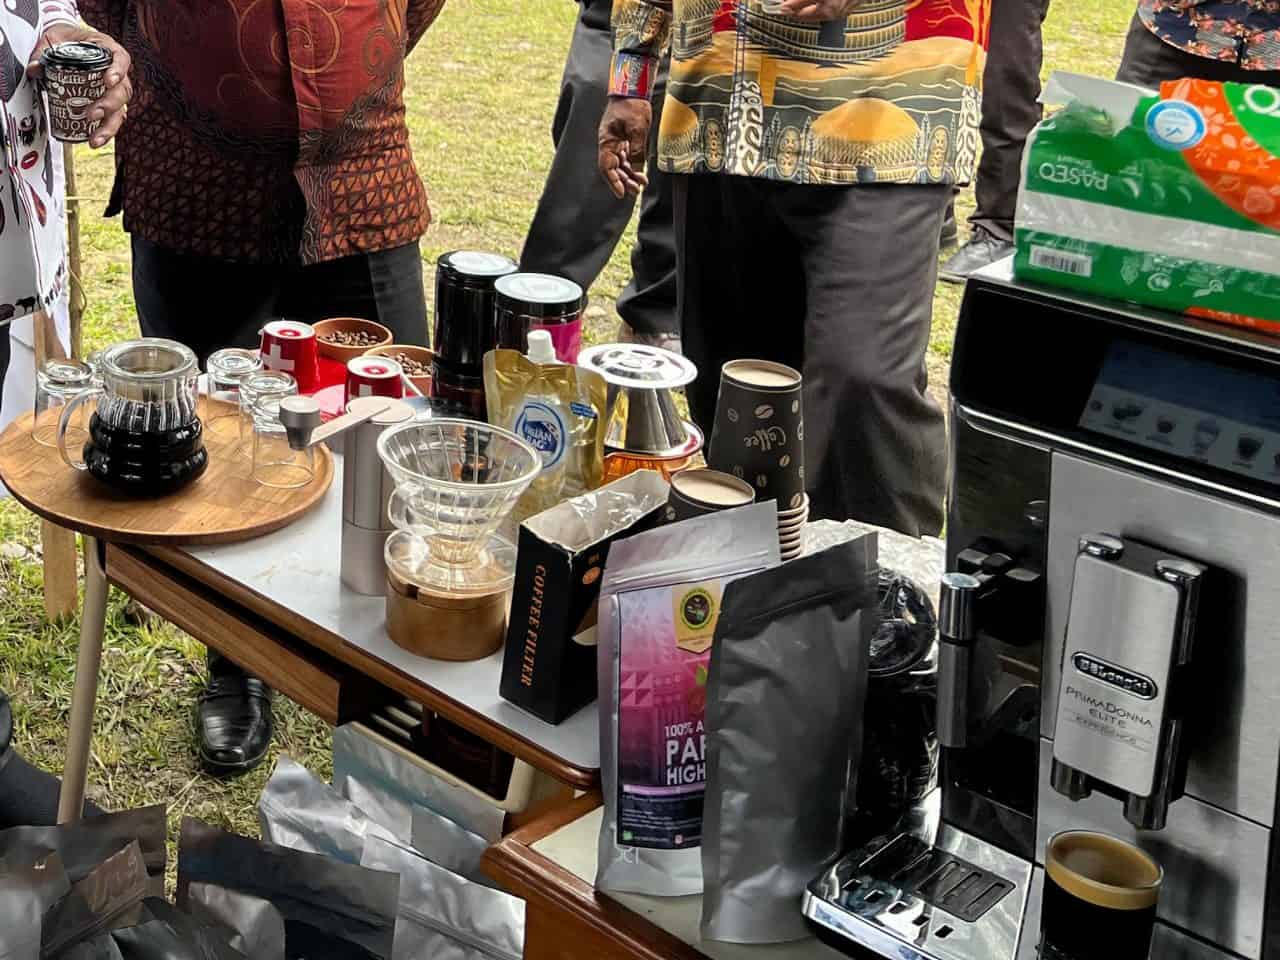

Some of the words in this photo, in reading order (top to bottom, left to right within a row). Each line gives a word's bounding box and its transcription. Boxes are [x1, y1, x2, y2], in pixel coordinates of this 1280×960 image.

[1038, 161, 1110, 191] PASEO
[743, 426, 786, 452] Coffee
[528, 564, 547, 628] COFFEE
[520, 629, 538, 687] FILTER
[1065, 685, 1153, 728] PRIMADONNA
[1088, 708, 1128, 728] ELITE
[665, 721, 694, 738] 100%
